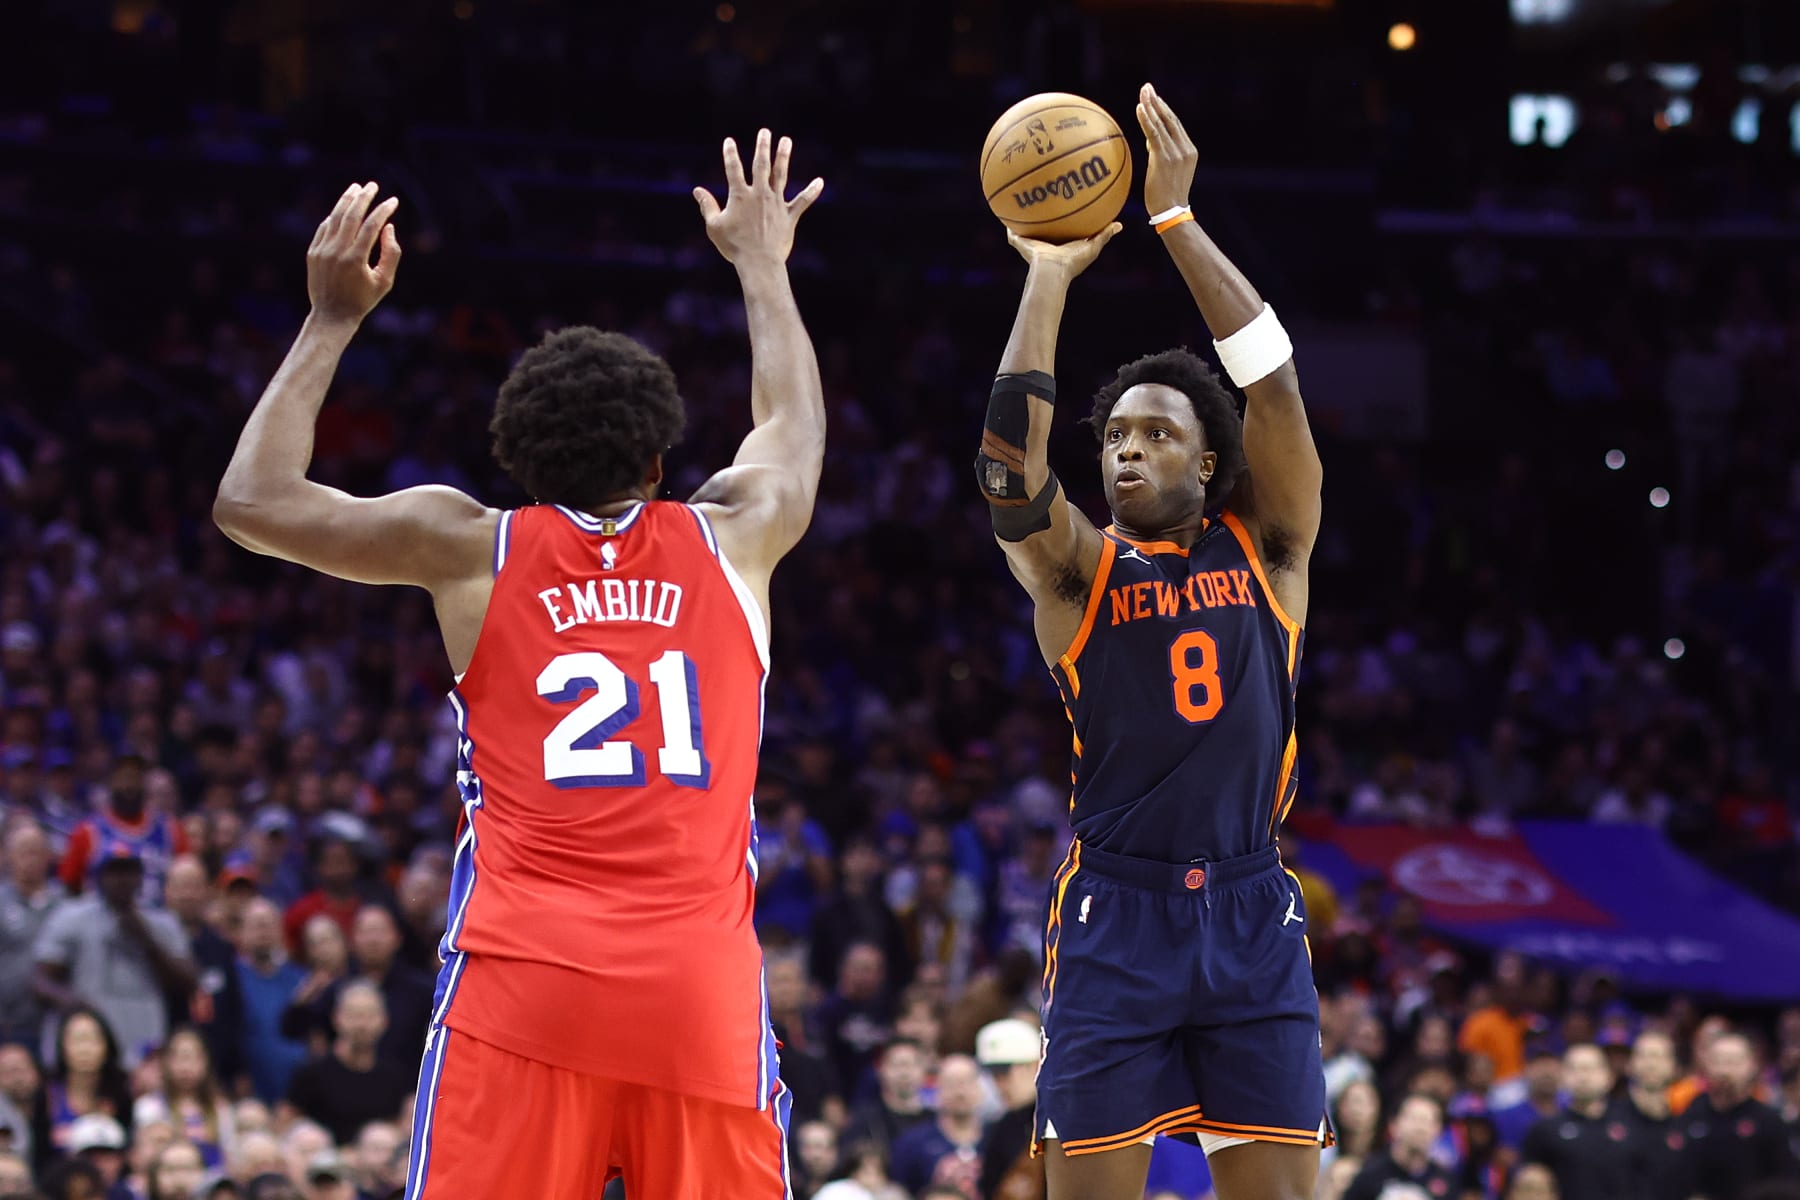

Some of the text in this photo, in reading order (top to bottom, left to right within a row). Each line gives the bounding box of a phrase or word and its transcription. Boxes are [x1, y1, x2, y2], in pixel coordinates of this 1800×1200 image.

[1013, 156, 1111, 208] Wilson
[537, 578, 683, 633] EMBIID
[1109, 569, 1256, 626] NEW YORK
[1169, 628, 1225, 725] 8
[535, 650, 711, 789] 21
